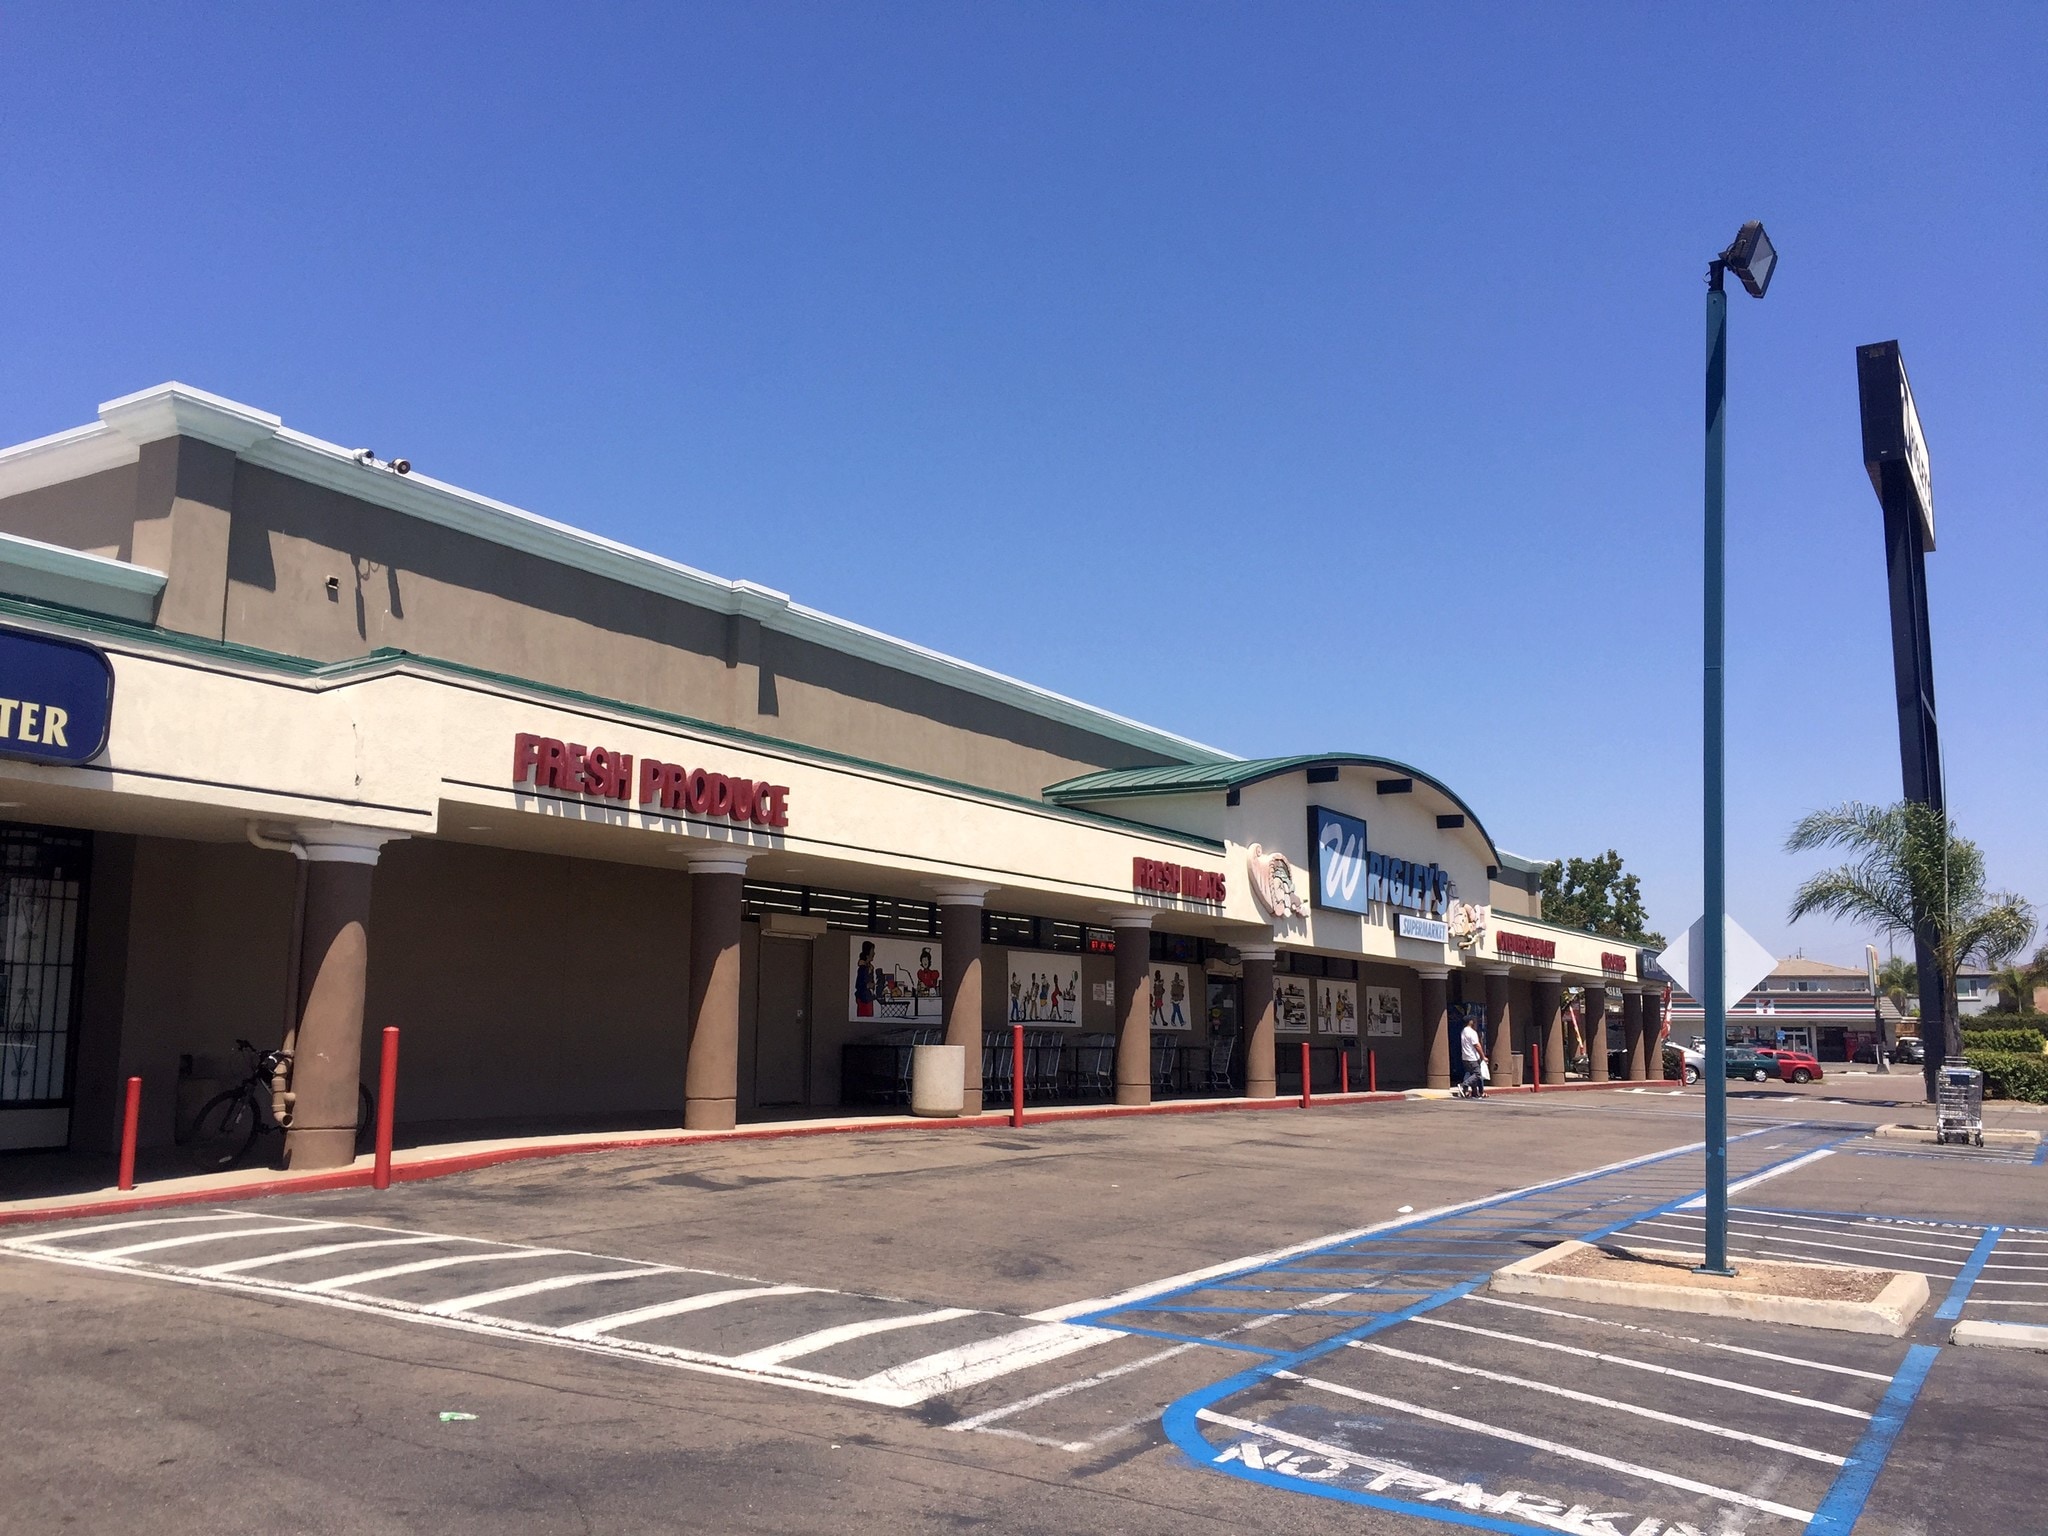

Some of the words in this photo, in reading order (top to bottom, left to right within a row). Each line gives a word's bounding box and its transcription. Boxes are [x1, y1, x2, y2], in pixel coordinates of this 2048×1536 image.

[512, 732, 634, 800] FRESH
[637, 758, 791, 828] PRODUCE
[1133, 856, 1181, 894] FRESH
[1181, 866, 1227, 902] MEATS
[1402, 917, 1447, 941] SUPERMARKET
[1213, 1442, 1349, 1479] NO
